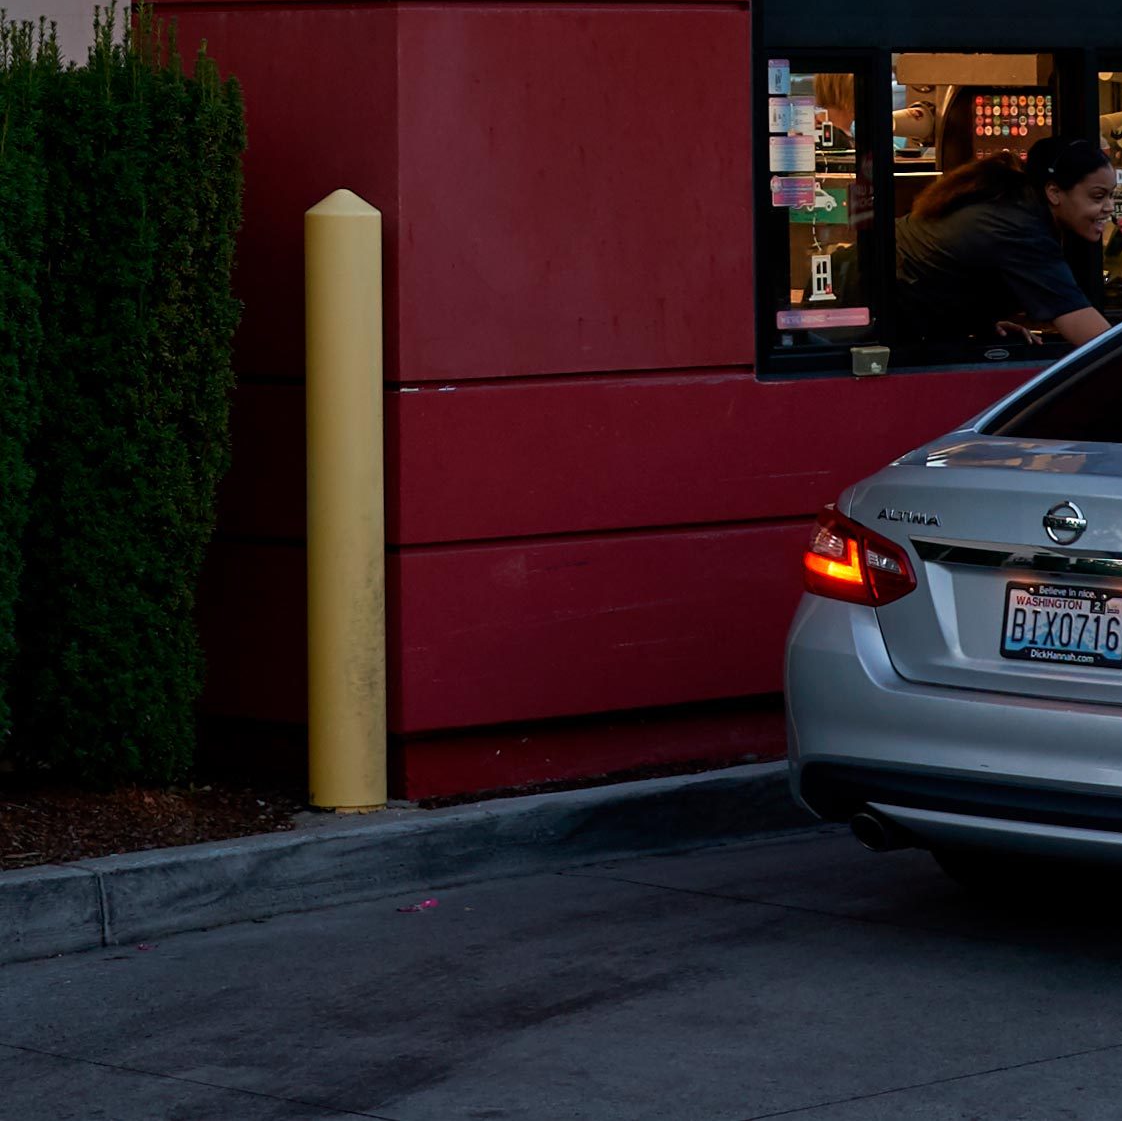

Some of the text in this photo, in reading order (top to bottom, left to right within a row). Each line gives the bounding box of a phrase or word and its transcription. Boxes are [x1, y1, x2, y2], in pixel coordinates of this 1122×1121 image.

[878, 508, 942, 527] ALTIMA
[1039, 585, 1097, 599] Believe in nice.
[1016, 596, 1083, 610] WASHINGTON
[1011, 608, 1120, 651] BIX0716
[1030, 649, 1094, 663] DickHannah.com
